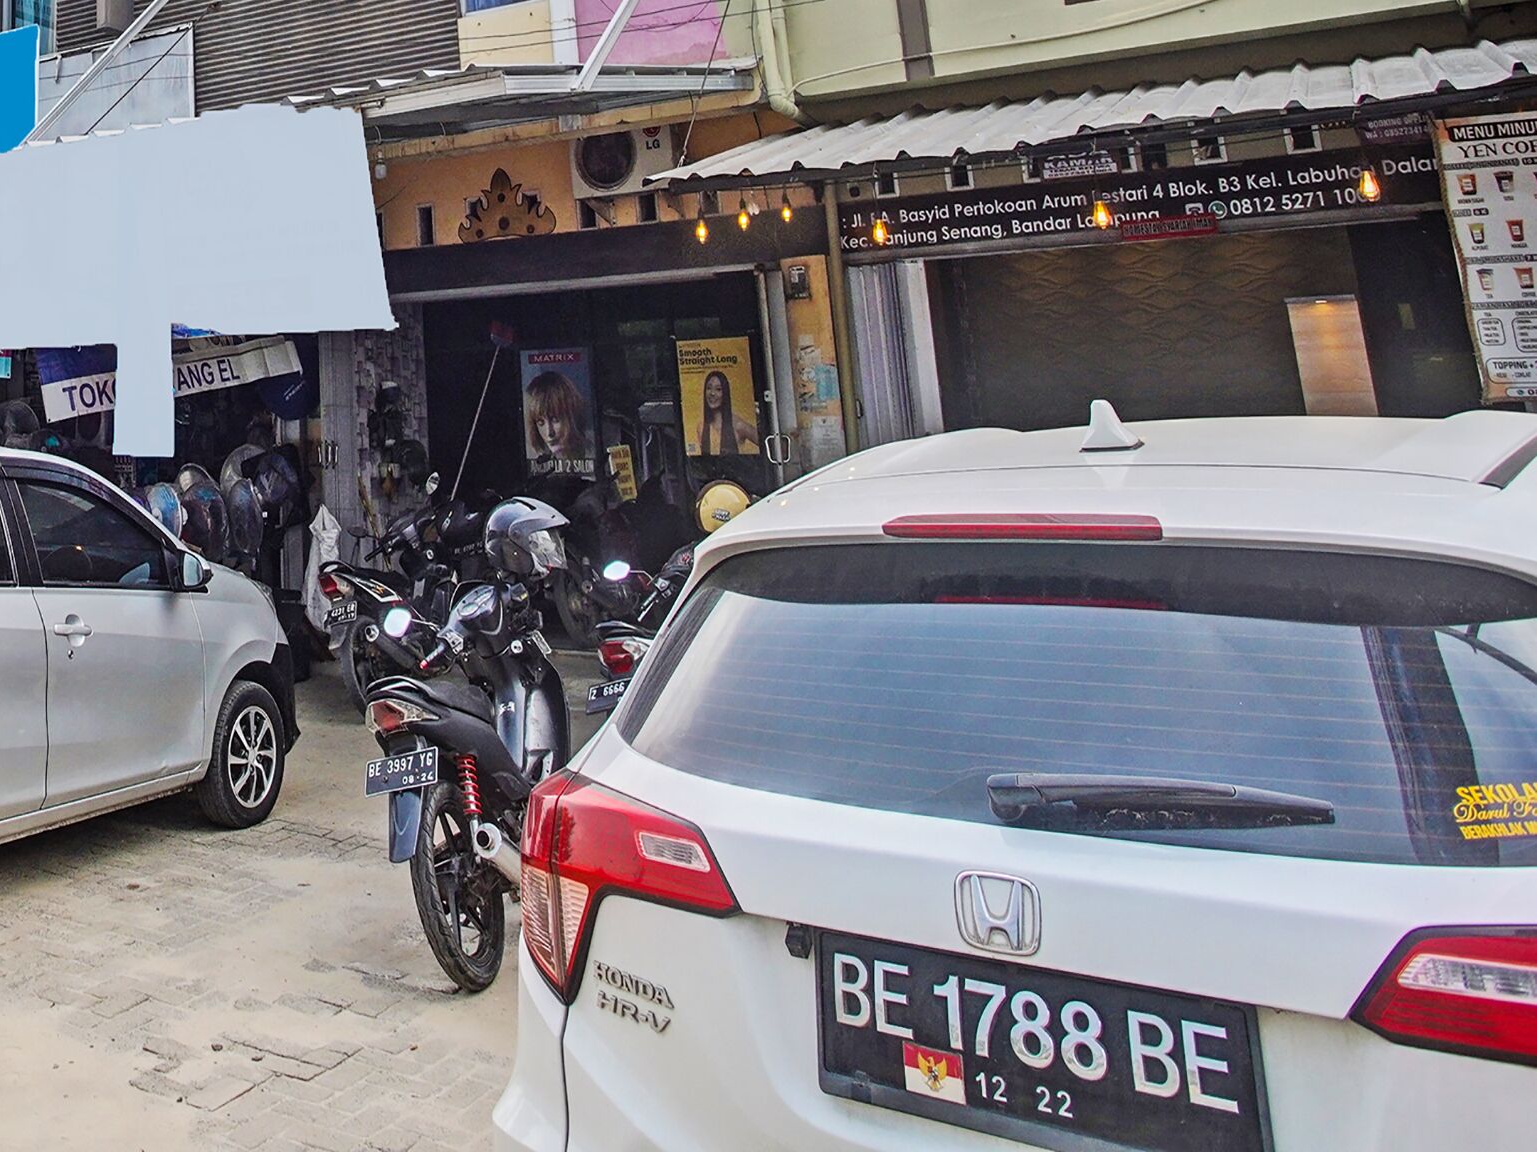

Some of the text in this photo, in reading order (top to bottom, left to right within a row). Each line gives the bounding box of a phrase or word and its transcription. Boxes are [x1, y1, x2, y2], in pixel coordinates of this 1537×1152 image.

[1453, 120, 1537, 140] MENU MINU
[646, 139, 660, 149] LG
[1458, 142, 1498, 159] YEN
[900, 203, 949, 225] Basyid
[955, 198, 1037, 218] Pertokoan
[1043, 193, 1087, 208] Arum
[1153, 184, 1163, 199] 4
[1169, 179, 1213, 197] Blok.
[1218, 176, 1241, 193] B3
[1246, 171, 1282, 190] Kel.
[840, 232, 873, 249] Kec.
[879, 227, 937, 246] anjung
[941, 225, 1008, 240] Senang,
[1013, 217, 1072, 234] Bandar
[1230, 195, 1275, 215] 0812
[1281, 192, 1325, 210] 5271
[534, 353, 575, 362] MATRIX
[679, 347, 712, 357] Smooth
[679, 355, 738, 365] Straight Long
[1493, 361, 1528, 370] TOPPING
[603, 682, 625, 696] 6666
[368, 751, 433, 778] BE 3997 YG
[1456, 782, 1537, 806] SEKOLA
[1453, 802, 1510, 823] Darul
[1459, 822, 1527, 840] BERAKHLAK
[593, 959, 675, 1010] HONDA
[597, 989, 671, 1034] HR-V
[833, 951, 1240, 1115] BE 1788 BE
[974, 1071, 1074, 1119] 12 22
